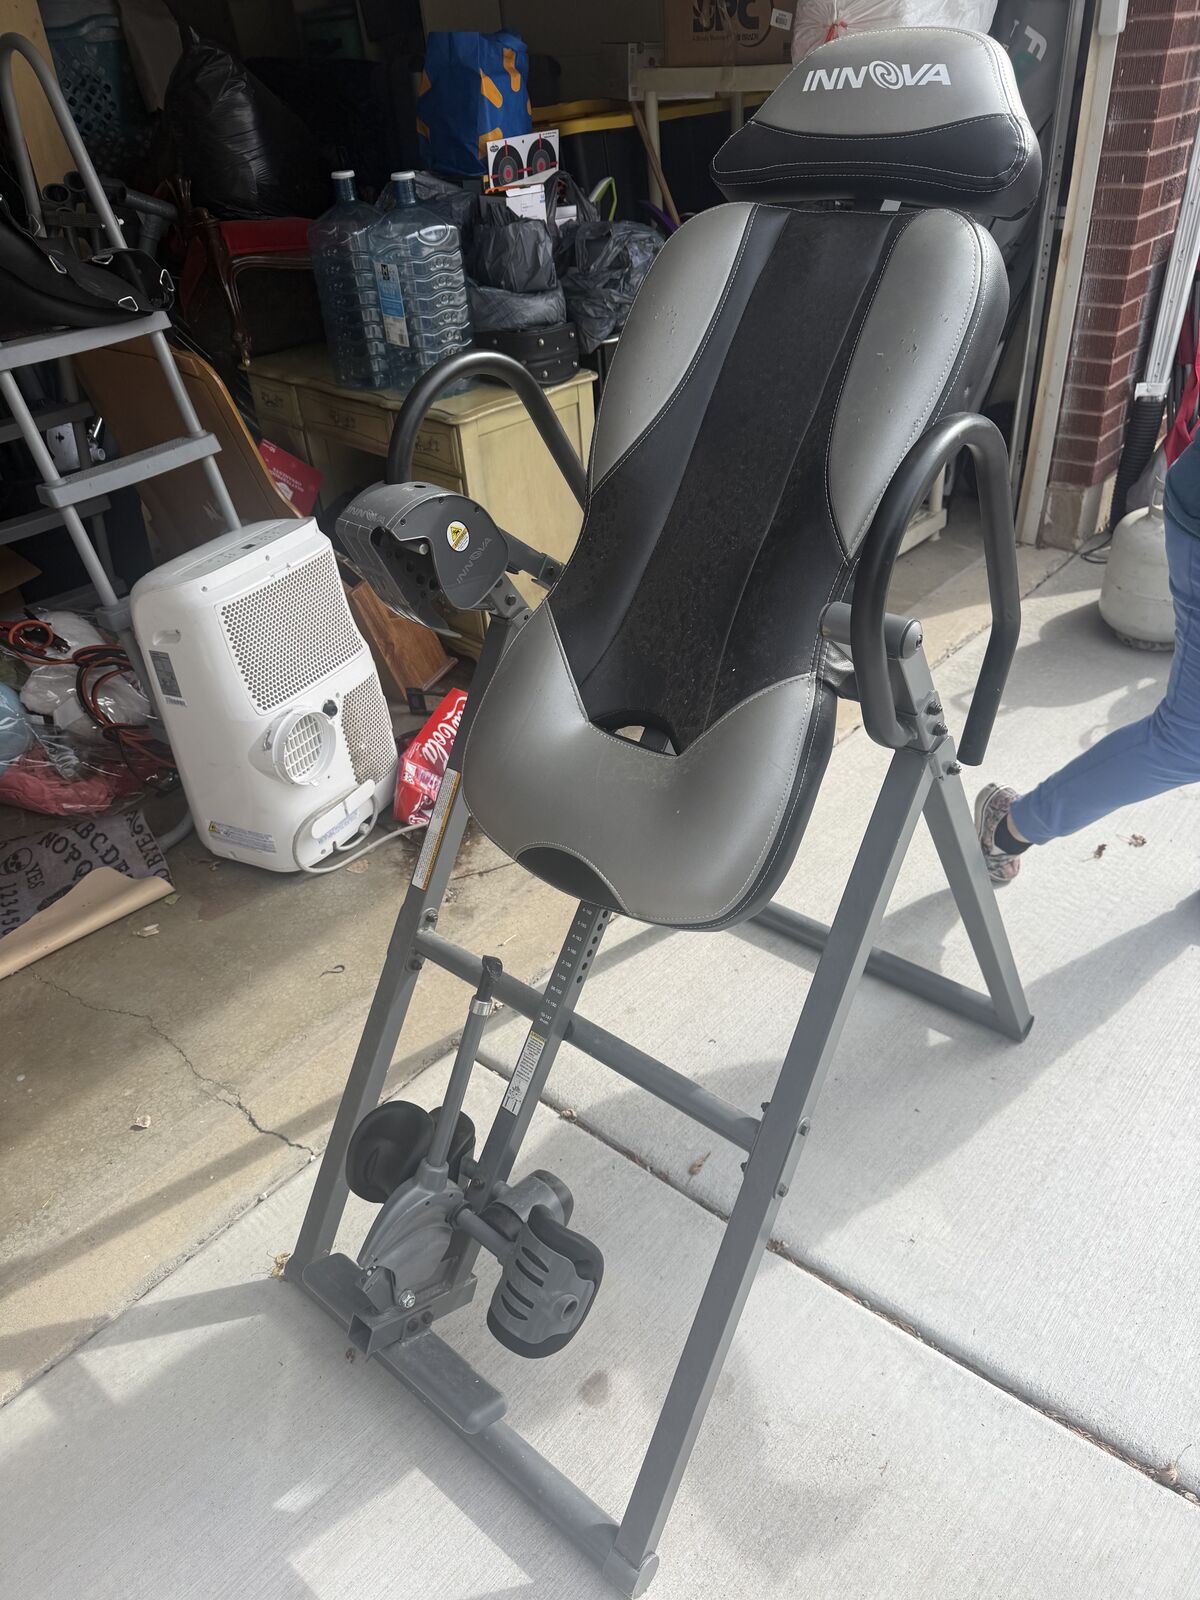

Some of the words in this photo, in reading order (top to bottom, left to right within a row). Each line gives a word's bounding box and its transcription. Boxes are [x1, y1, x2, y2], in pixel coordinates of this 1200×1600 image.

[803, 60, 951, 92] INNOVA
[346, 504, 387, 524] INNOVA
[456, 537, 493, 584] INNOVA
[24, 862, 45, 889] YES
